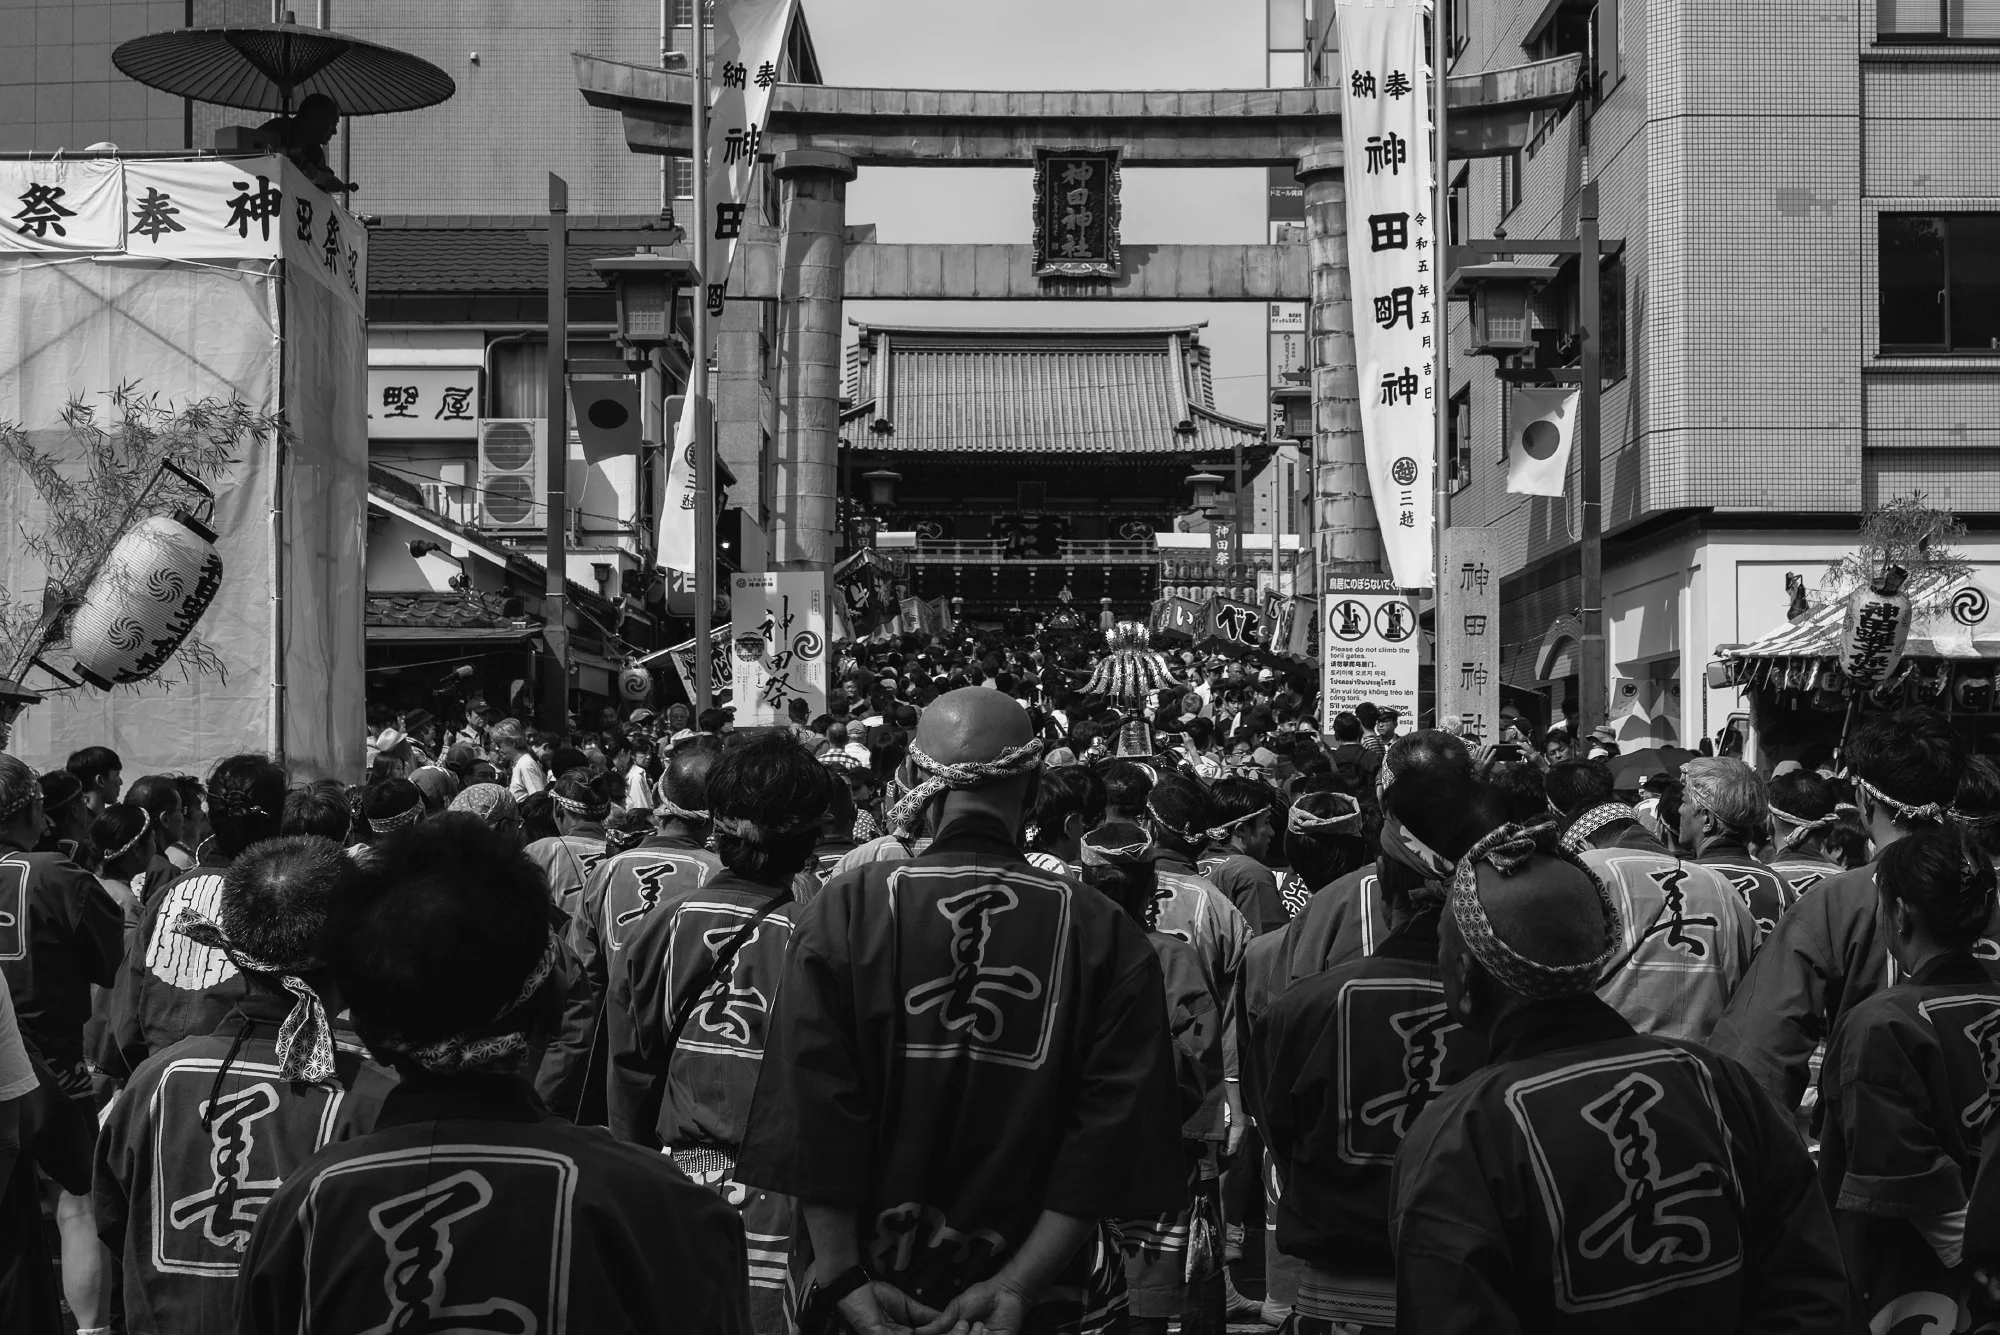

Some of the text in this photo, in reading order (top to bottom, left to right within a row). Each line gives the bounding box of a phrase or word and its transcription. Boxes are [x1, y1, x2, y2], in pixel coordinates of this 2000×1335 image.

[1351, 70, 1413, 101] 奉納
[17, 182, 77, 238] 祭
[1061, 160, 1094, 258] 神田神社
[1364, 131, 1419, 407] 神田明神
[1414, 211, 1433, 400] 令和五年五月吉日
[367, 385, 474, 421] 野屋
[1399, 490, 1416, 528] 三越
[1215, 525, 1230, 566] 神田祭
[1329, 577, 1400, 591] 鳥居にのぼらないでく
[756, 594, 811, 710] 神田祭
[1330, 645, 1353, 653] Please
[1460, 562, 1490, 739] 神田神社
